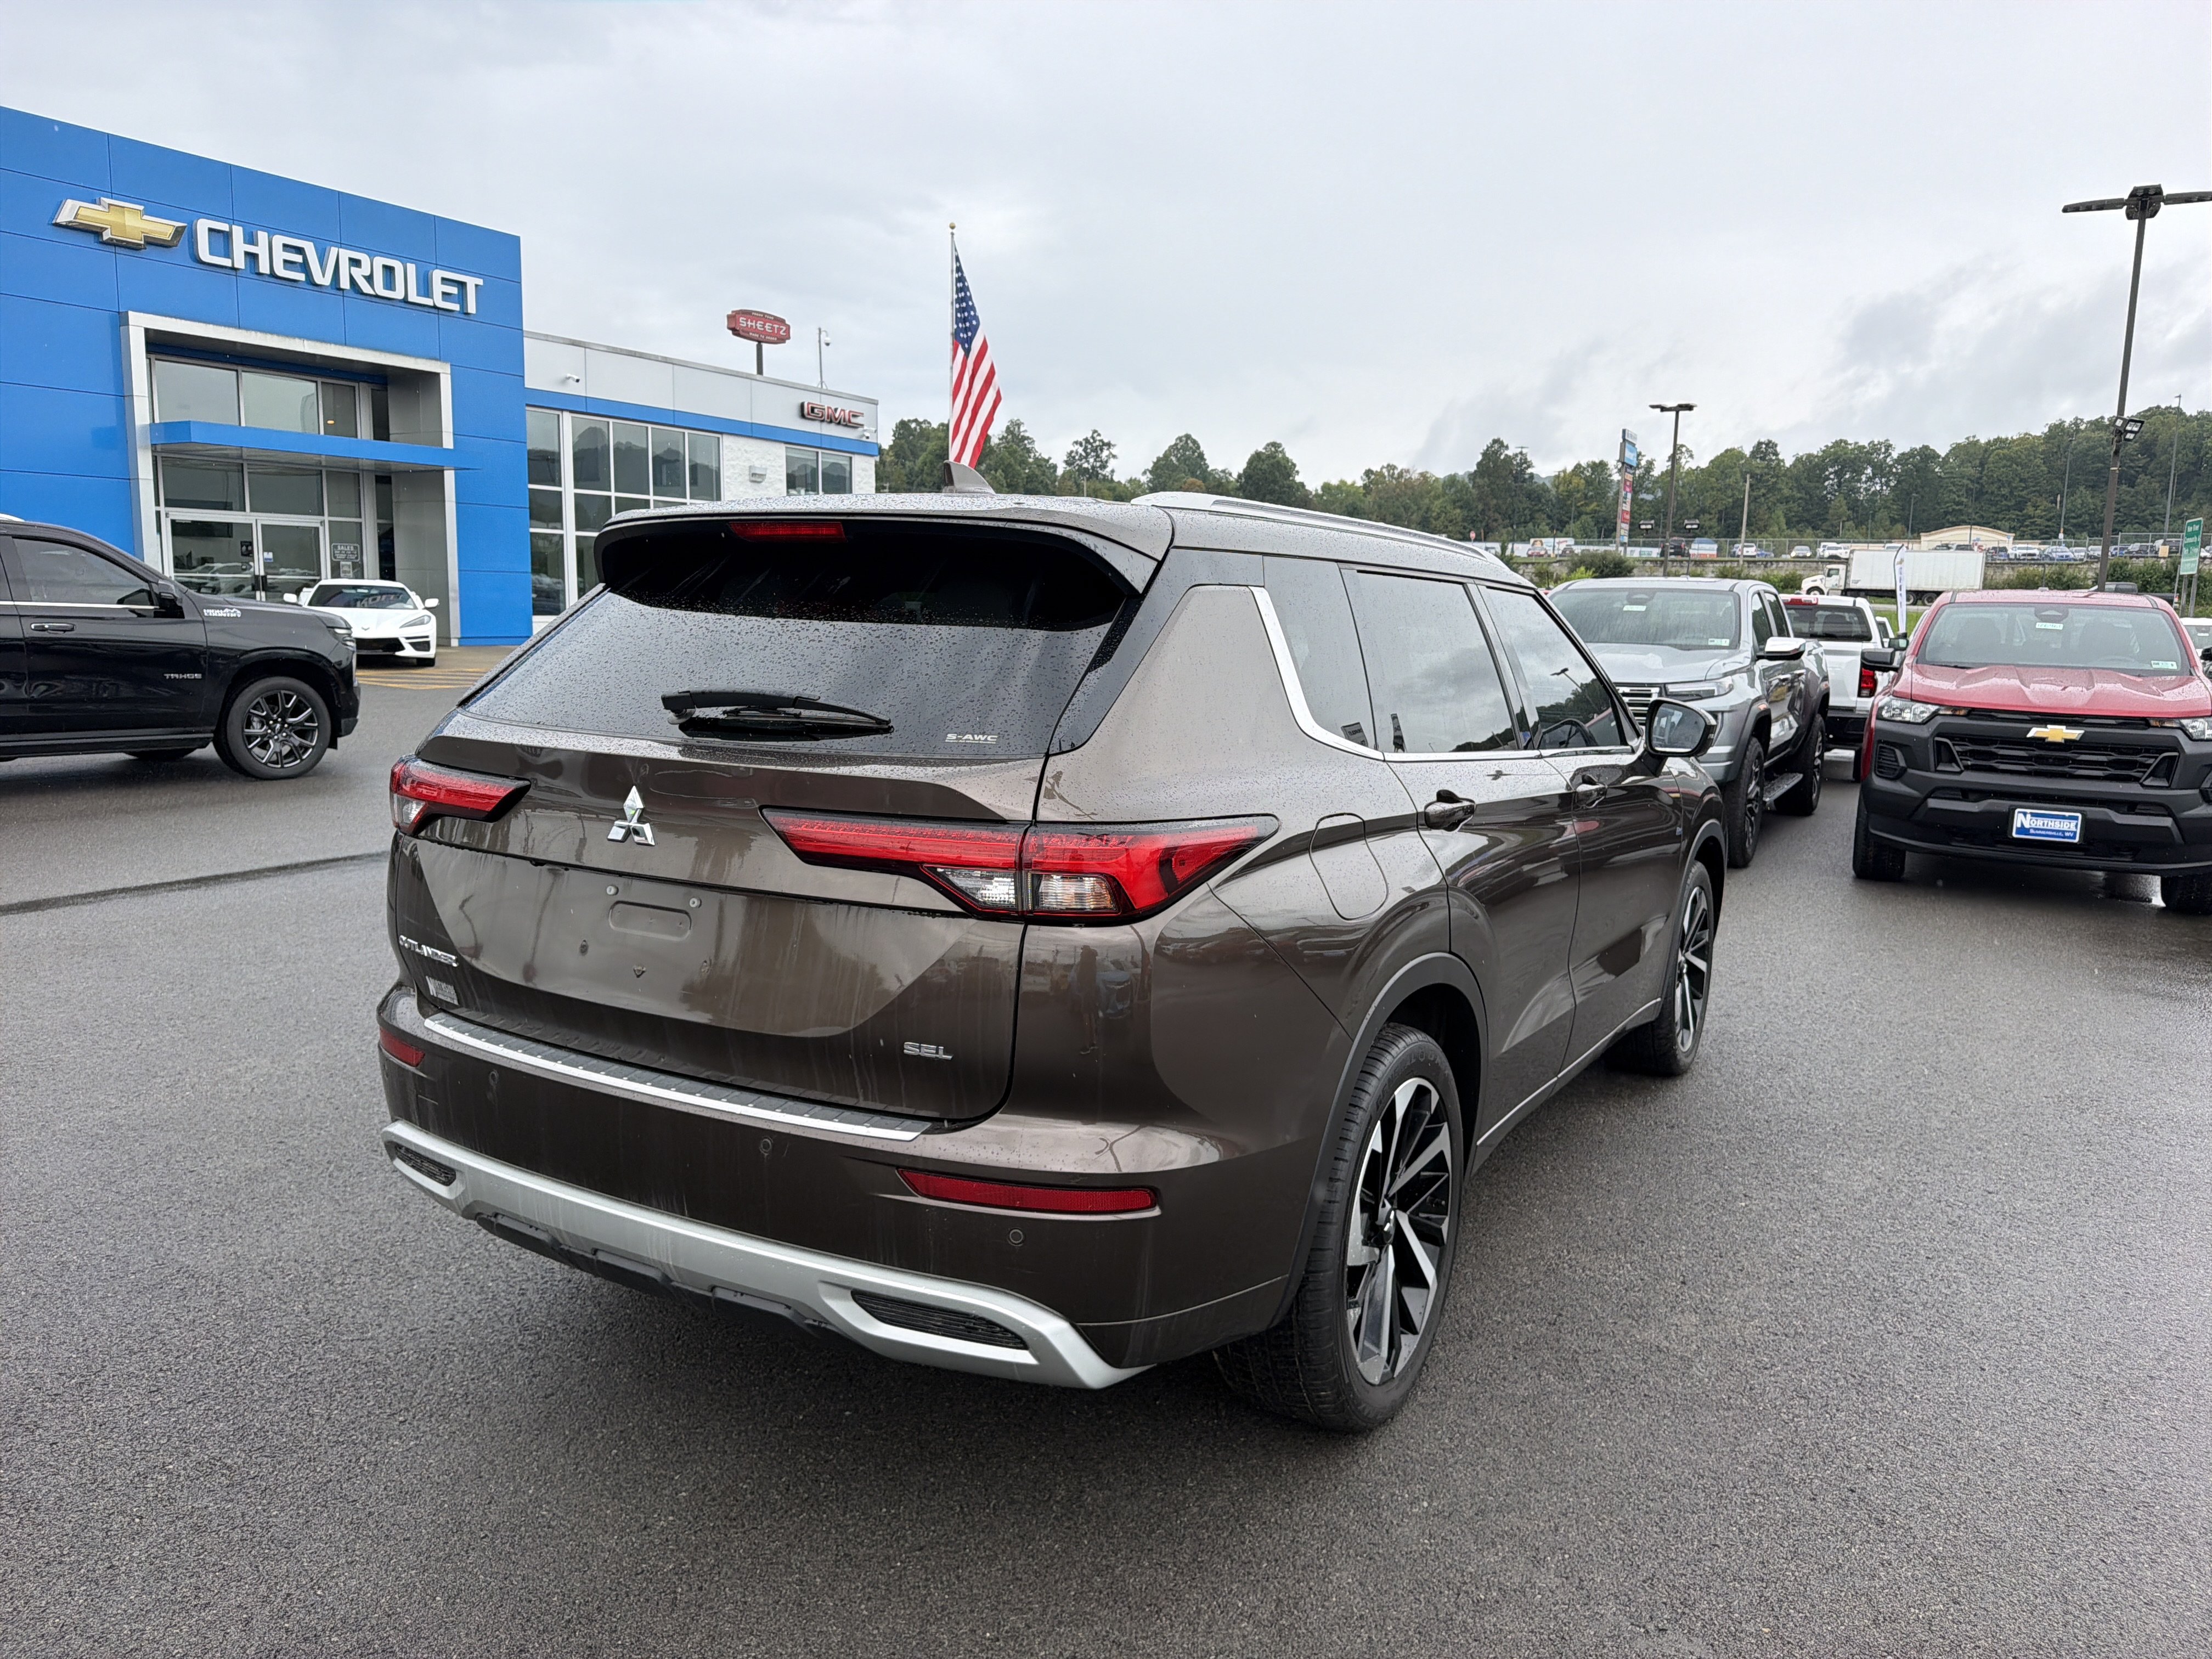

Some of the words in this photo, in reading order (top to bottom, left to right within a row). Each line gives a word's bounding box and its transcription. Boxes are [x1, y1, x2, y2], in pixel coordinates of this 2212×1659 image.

[195, 218, 483, 314] CHEVROLET
[739, 317, 786, 336] SHEETZ
[804, 401, 865, 427] GMC
[2016, 813, 2077, 830] NORTHSIDE
[903, 1042, 953, 1060] SEL
